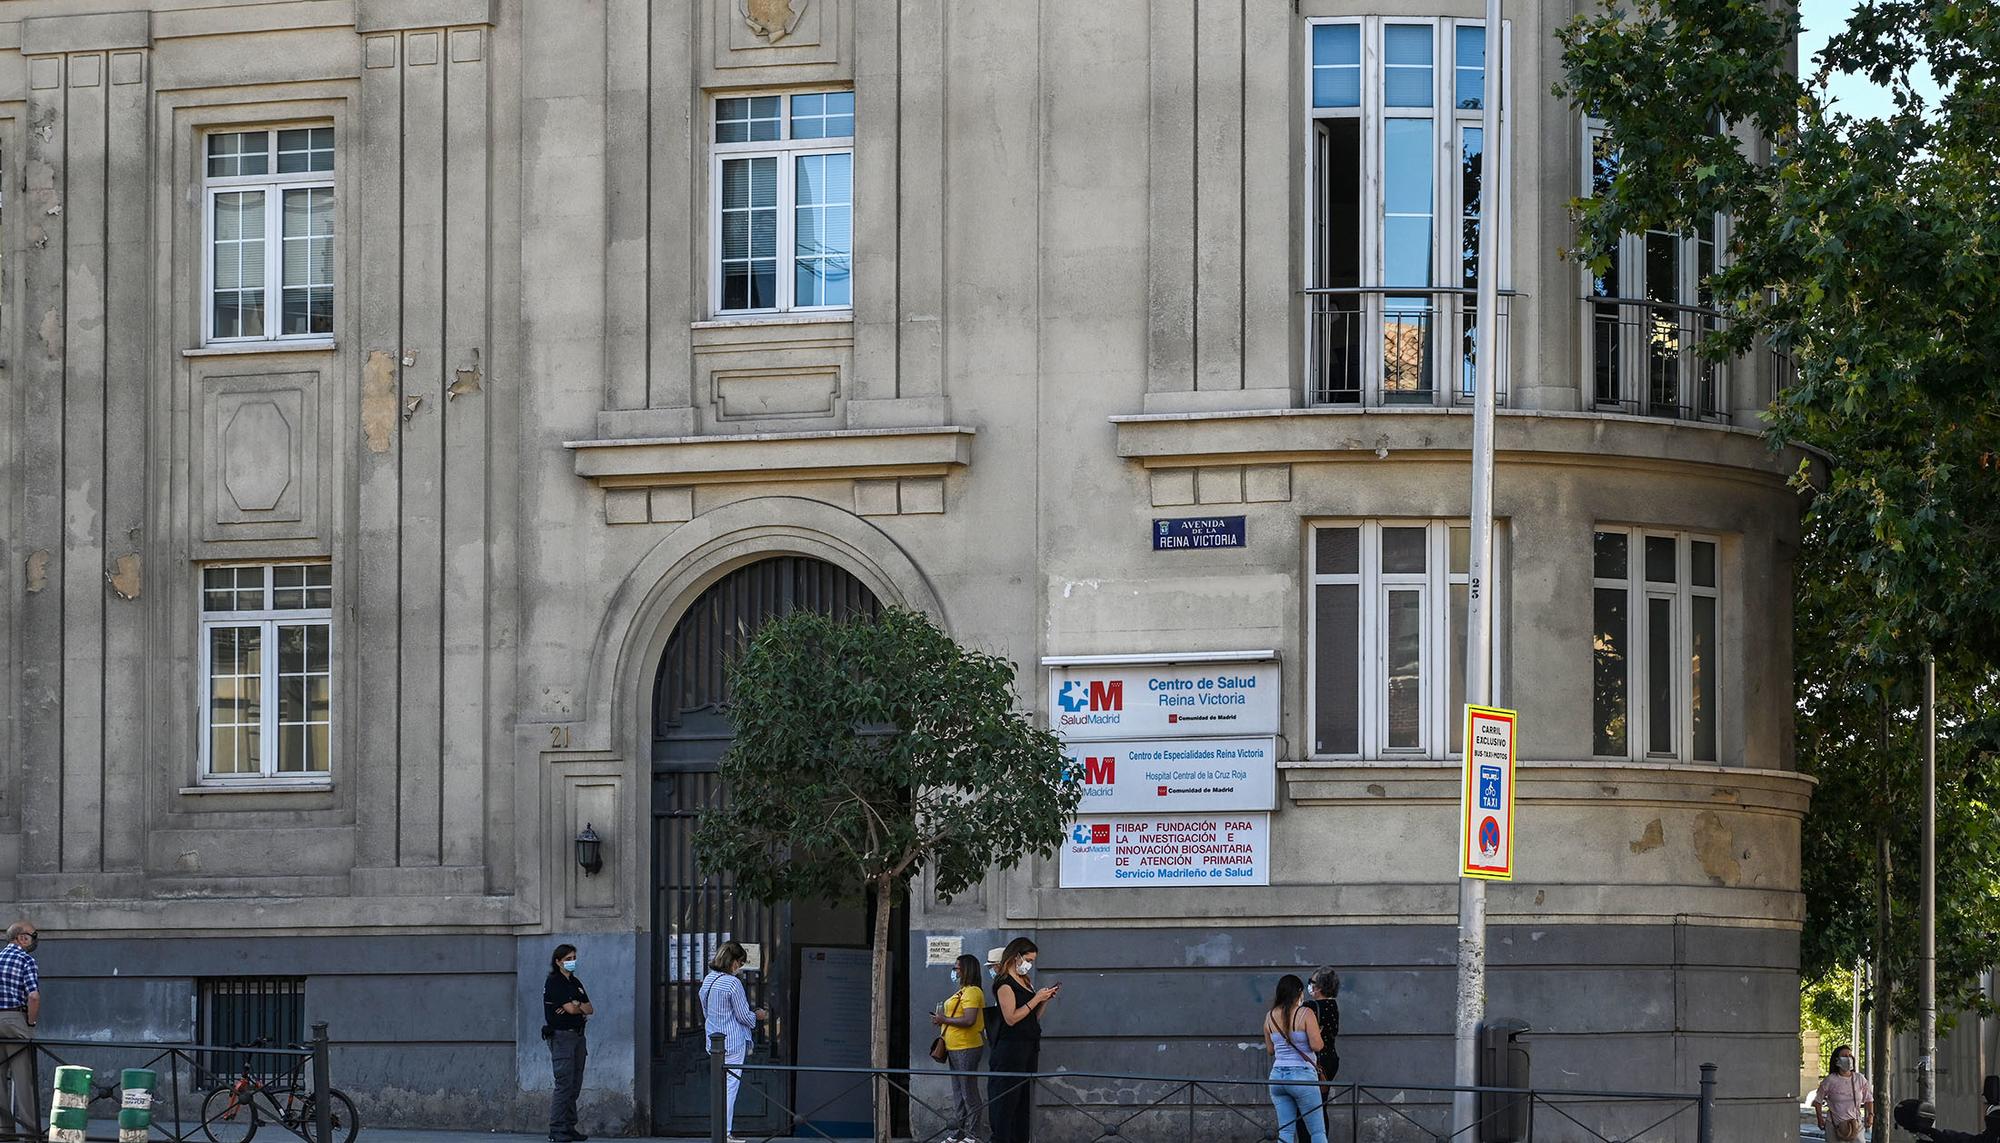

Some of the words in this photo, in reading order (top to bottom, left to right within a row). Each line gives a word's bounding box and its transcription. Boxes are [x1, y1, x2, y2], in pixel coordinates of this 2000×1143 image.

[1181, 520, 1225, 529] AVENIDA
[1160, 536, 1189, 548] REINA
[1193, 534, 1237, 546] VICTORIA
[1471, 578, 1480, 599] 25
[1148, 678, 1194, 691] Centro
[1197, 677, 1214, 689] de
[1217, 676, 1256, 689] Salud
[1159, 694, 1195, 706] Reina
[1198, 692, 1245, 705] Victoria
[1060, 714, 1120, 725] SaludMadrid
[1482, 726, 1501, 735] CARRIL
[550, 725, 569, 748] 21
[1476, 736, 1507, 747] EXCLUSIVO
[1129, 751, 1151, 760] Centro
[1153, 751, 1162, 760] de
[1164, 750, 1214, 761] Especialidades
[1216, 750, 1236, 758] Reina
[1237, 749, 1264, 758] Victoria
[1146, 772, 1171, 781] Hospital
[1173, 771, 1196, 780] Central
[1197, 771, 1206, 780] de
[1207, 771, 1214, 779] la
[1214, 770, 1230, 780] Cruz
[1232, 770, 1247, 780] Roja
[1483, 797, 1498, 807] TAXI
[1116, 823, 1148, 832] FIIBAP
[1156, 820, 1216, 832] FUNDACIÓN
[1224, 822, 1252, 830] PARA
[1116, 835, 1128, 844] LA
[1140, 832, 1216, 843] INVESTIGACIÓN
[1228, 833, 1234, 842] E
[1072, 845, 1110, 853] SaludMadrid
[1116, 843, 1178, 854] INNOVACIÓN
[1182, 844, 1252, 854] BIOSANITARIA
[1116, 857, 1129, 866] DE
[1140, 855, 1192, 866] ATENCIÓN
[1203, 856, 1252, 865] PRIMARIA
[1115, 869, 1155, 878] Servicio
[1158, 868, 1207, 878] Madrileño
[1210, 868, 1222, 877] de
[1224, 868, 1253, 877] Salud
